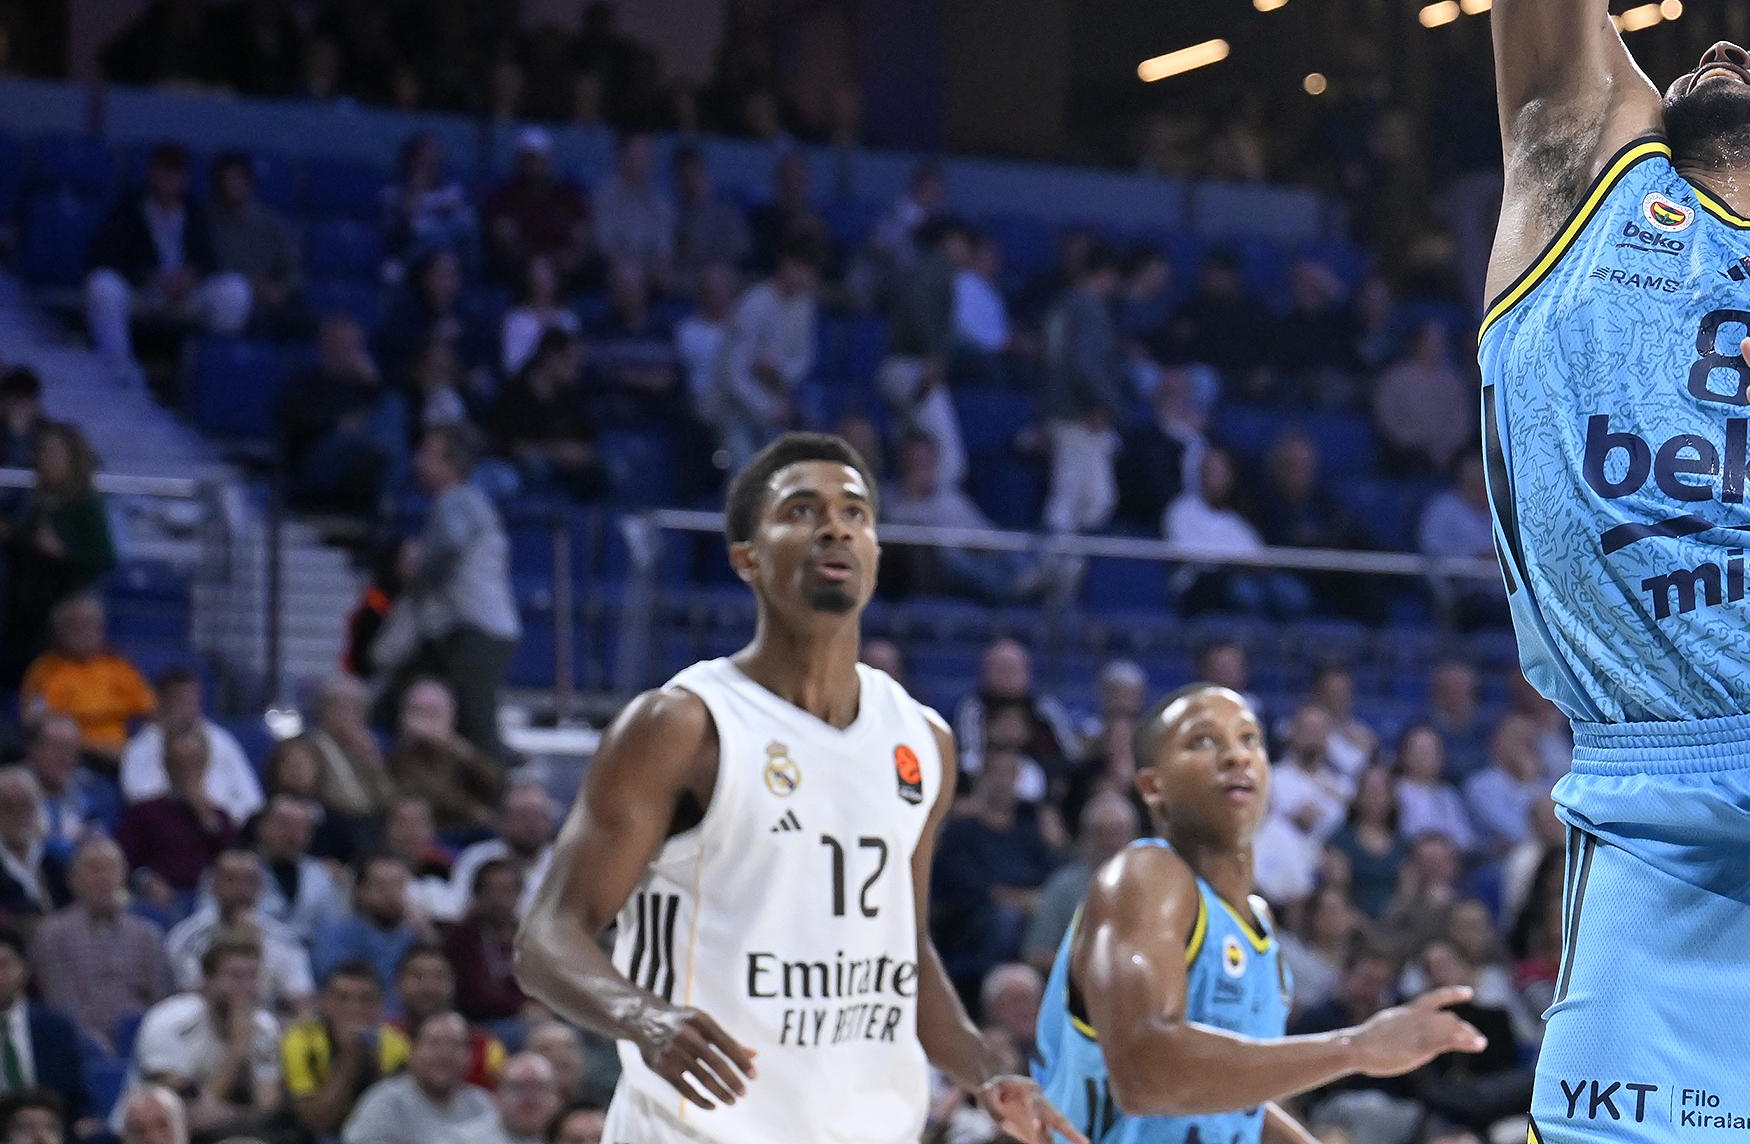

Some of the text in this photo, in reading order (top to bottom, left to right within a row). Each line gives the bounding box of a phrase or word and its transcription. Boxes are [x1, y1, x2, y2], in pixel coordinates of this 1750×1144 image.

[1623, 221, 1685, 251] beko
[1609, 269, 1681, 293] RAMS
[821, 833, 888, 918] 12
[780, 1009, 827, 1046] FLY
[1560, 1079, 1659, 1123] YKT
[1681, 1088, 1721, 1108] Filo
